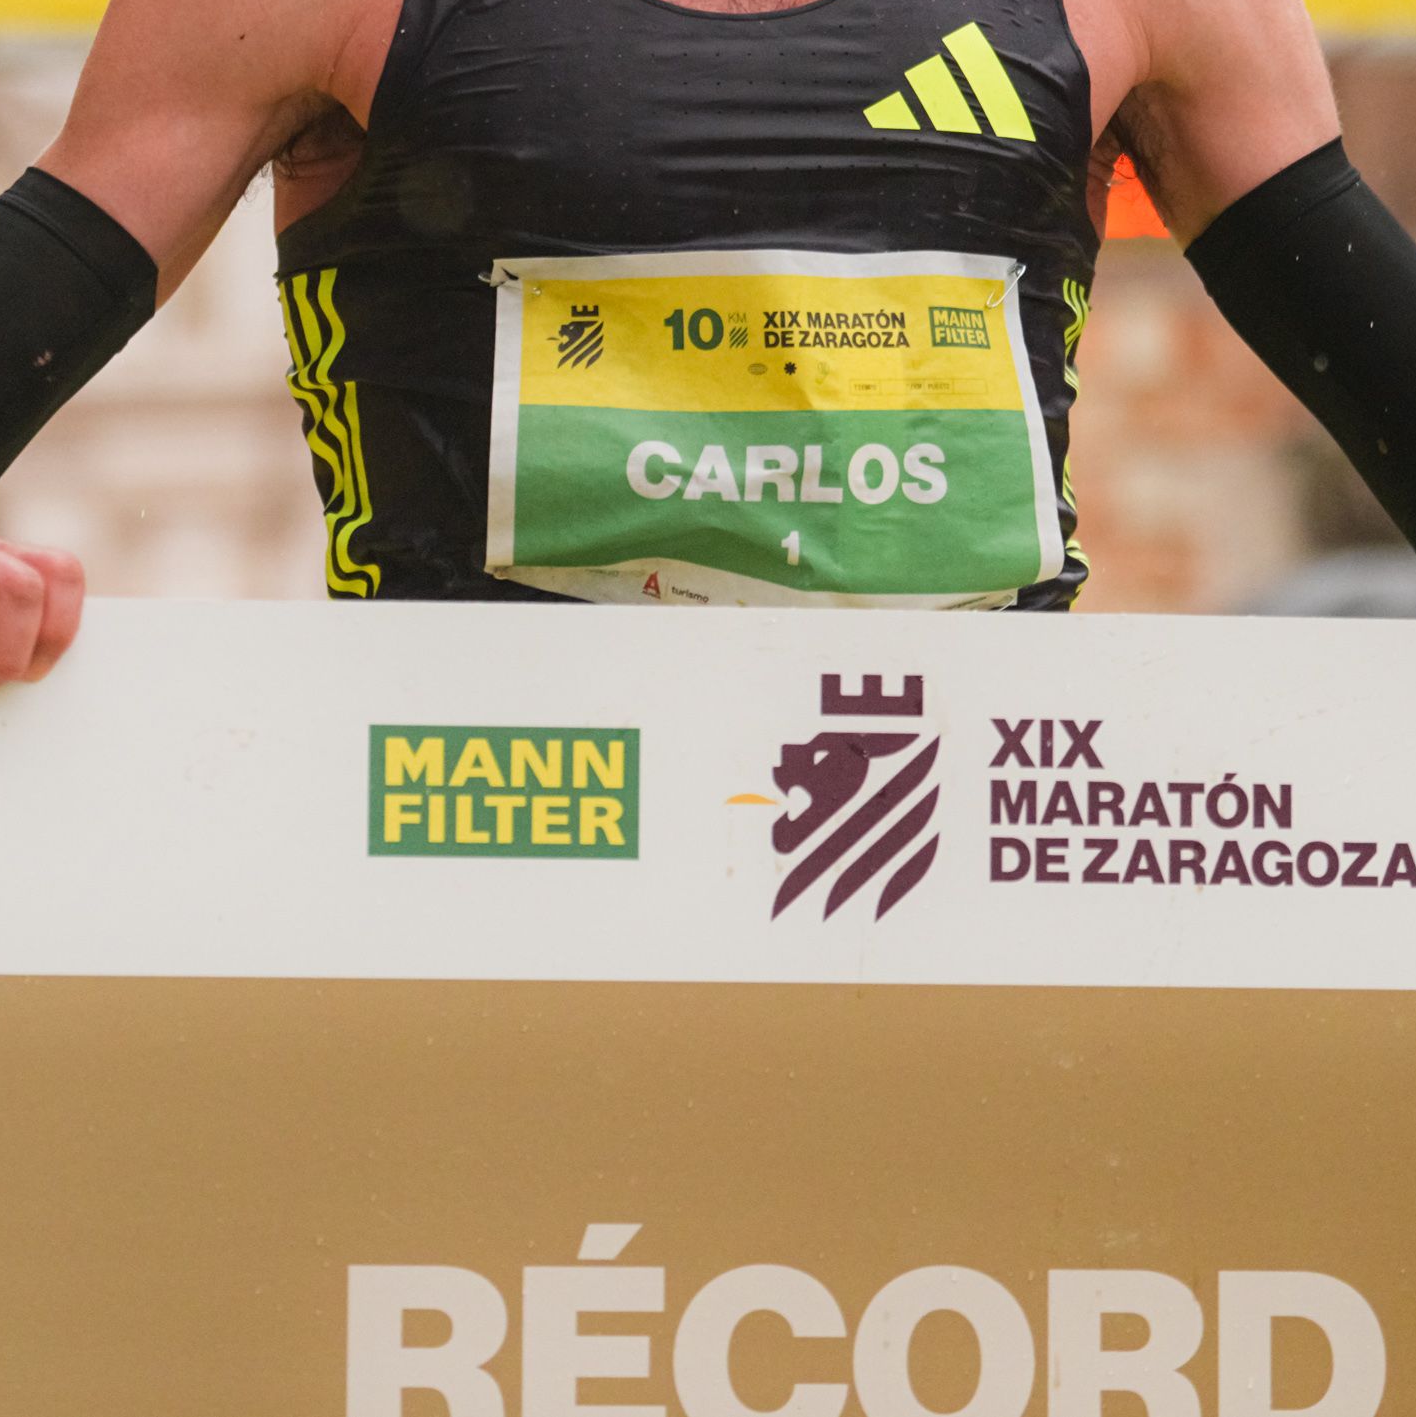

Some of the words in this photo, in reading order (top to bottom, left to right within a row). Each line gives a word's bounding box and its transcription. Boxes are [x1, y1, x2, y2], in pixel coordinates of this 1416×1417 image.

[664, 308, 724, 350] 10
[728, 312, 747, 324] KM
[763, 311, 801, 329] XIX
[807, 309, 906, 329] MARATÓN
[934, 310, 983, 329] MANN
[935, 327, 987, 346] FILTER
[764, 331, 795, 348] DE
[799, 331, 910, 349] ZARAGOZA
[626, 440, 948, 505] CARLOS
[781, 531, 800, 565] 1
[671, 585, 710, 604] turismo
[384, 737, 625, 789] MANN
[988, 718, 1105, 769] XIX
[384, 794, 626, 846] FILTER
[989, 773, 1293, 829] MARATÓN
[989, 837, 1070, 883] DE
[347, 1222, 1387, 1417] RÉCORD
